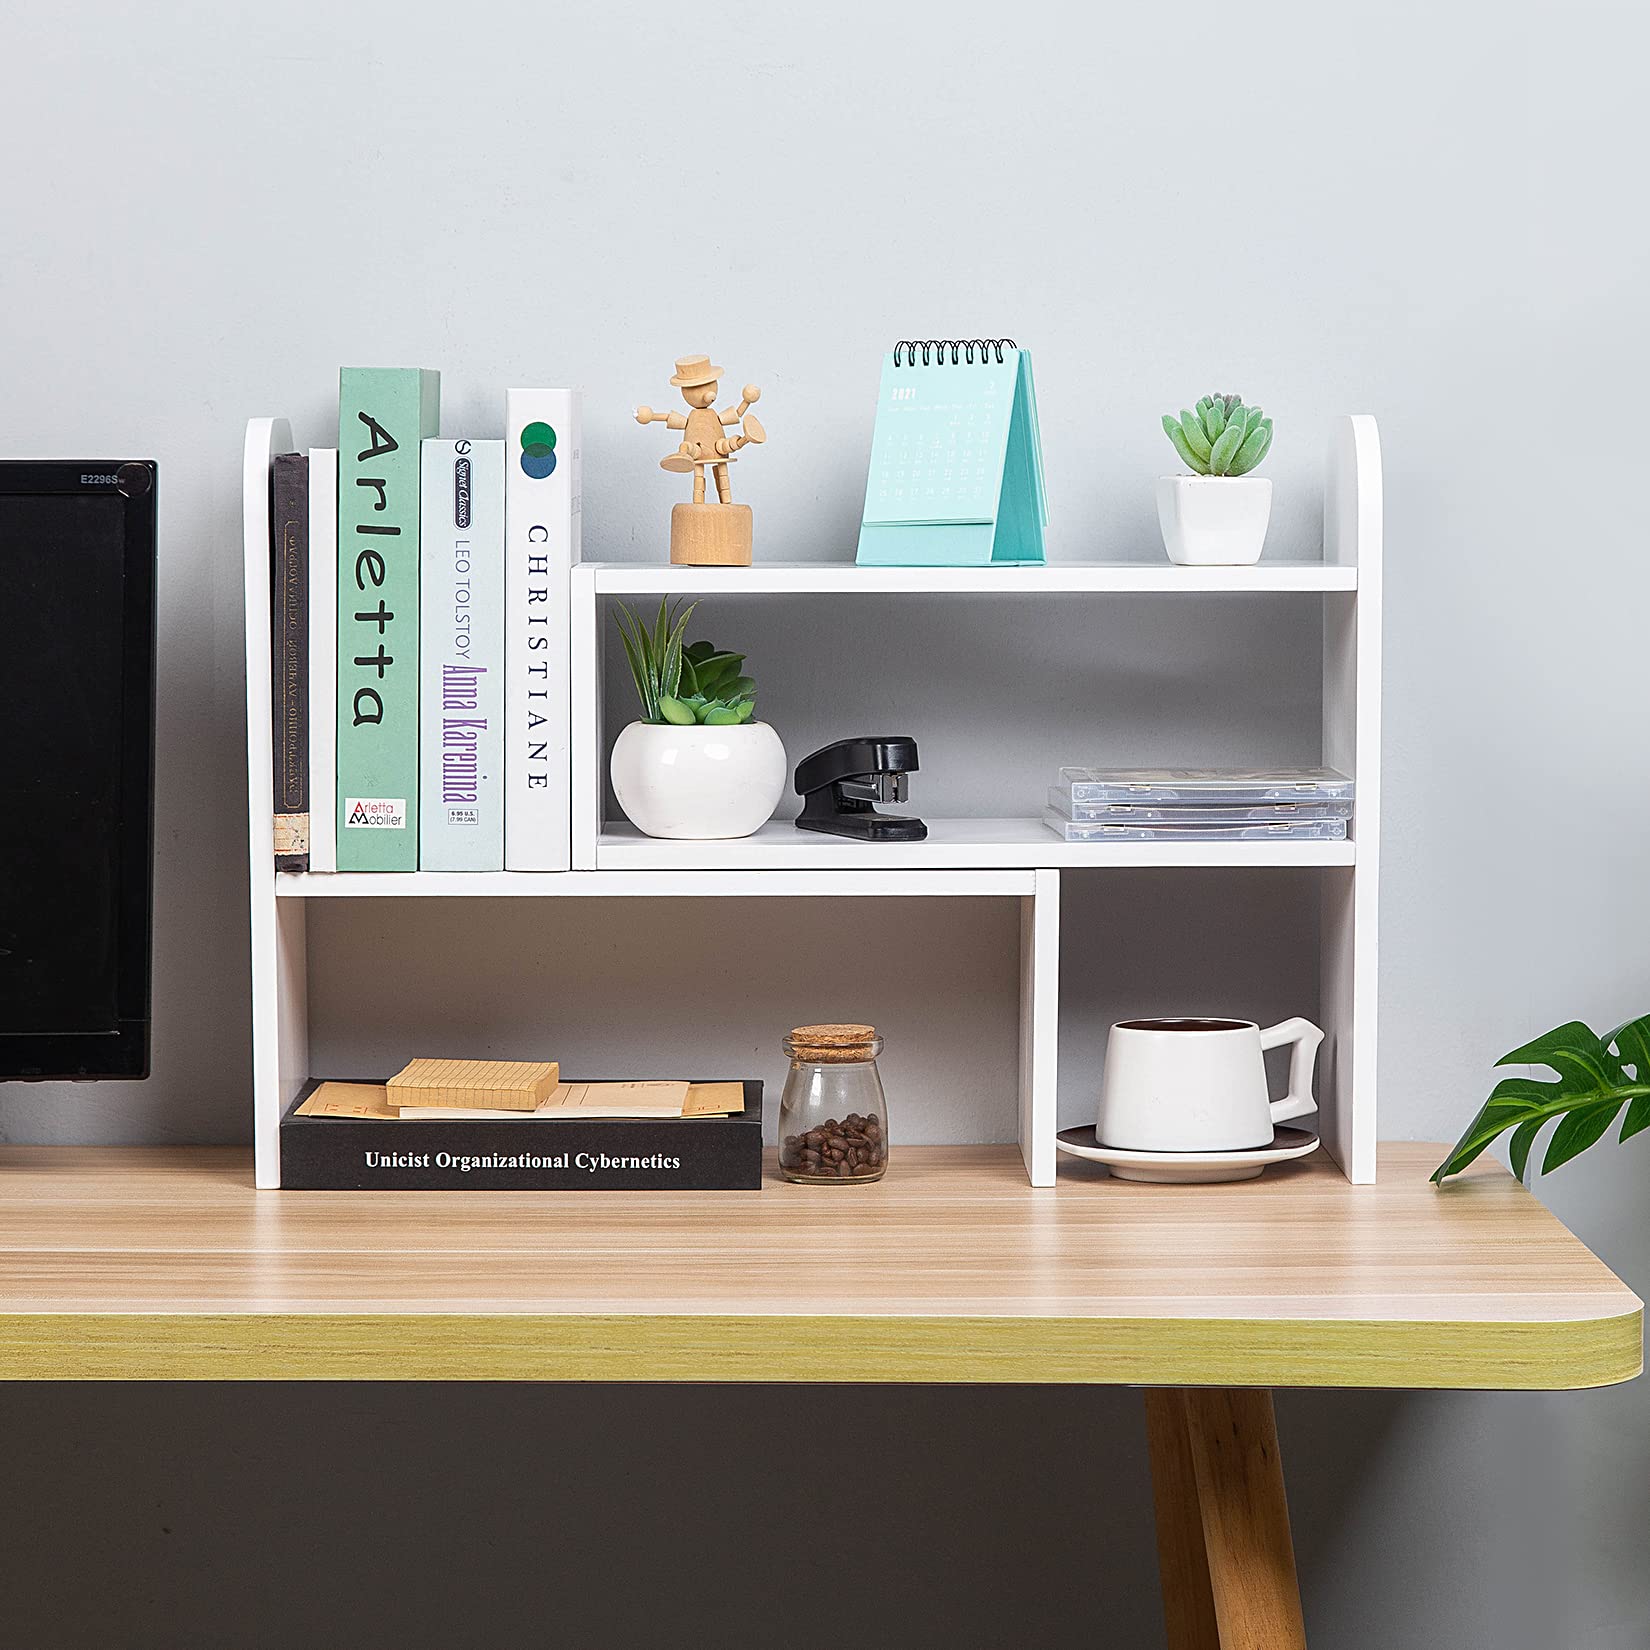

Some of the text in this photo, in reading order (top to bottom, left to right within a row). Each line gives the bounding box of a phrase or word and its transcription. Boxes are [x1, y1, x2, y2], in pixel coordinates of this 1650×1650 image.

[891, 387, 916, 401] 2021
[456, 459, 469, 527] Signet Classics
[352, 410, 402, 728] Arletta
[455, 540, 471, 660] LEO TOLSTOY
[527, 525, 549, 790] CHRISTIANE
[443, 664, 488, 803] Anna Karenina
[348, 812, 402, 825] Mobilier
[354, 801, 394, 813] Arletta
[364, 1151, 681, 1173] Unicist Organizational Cybernetics
